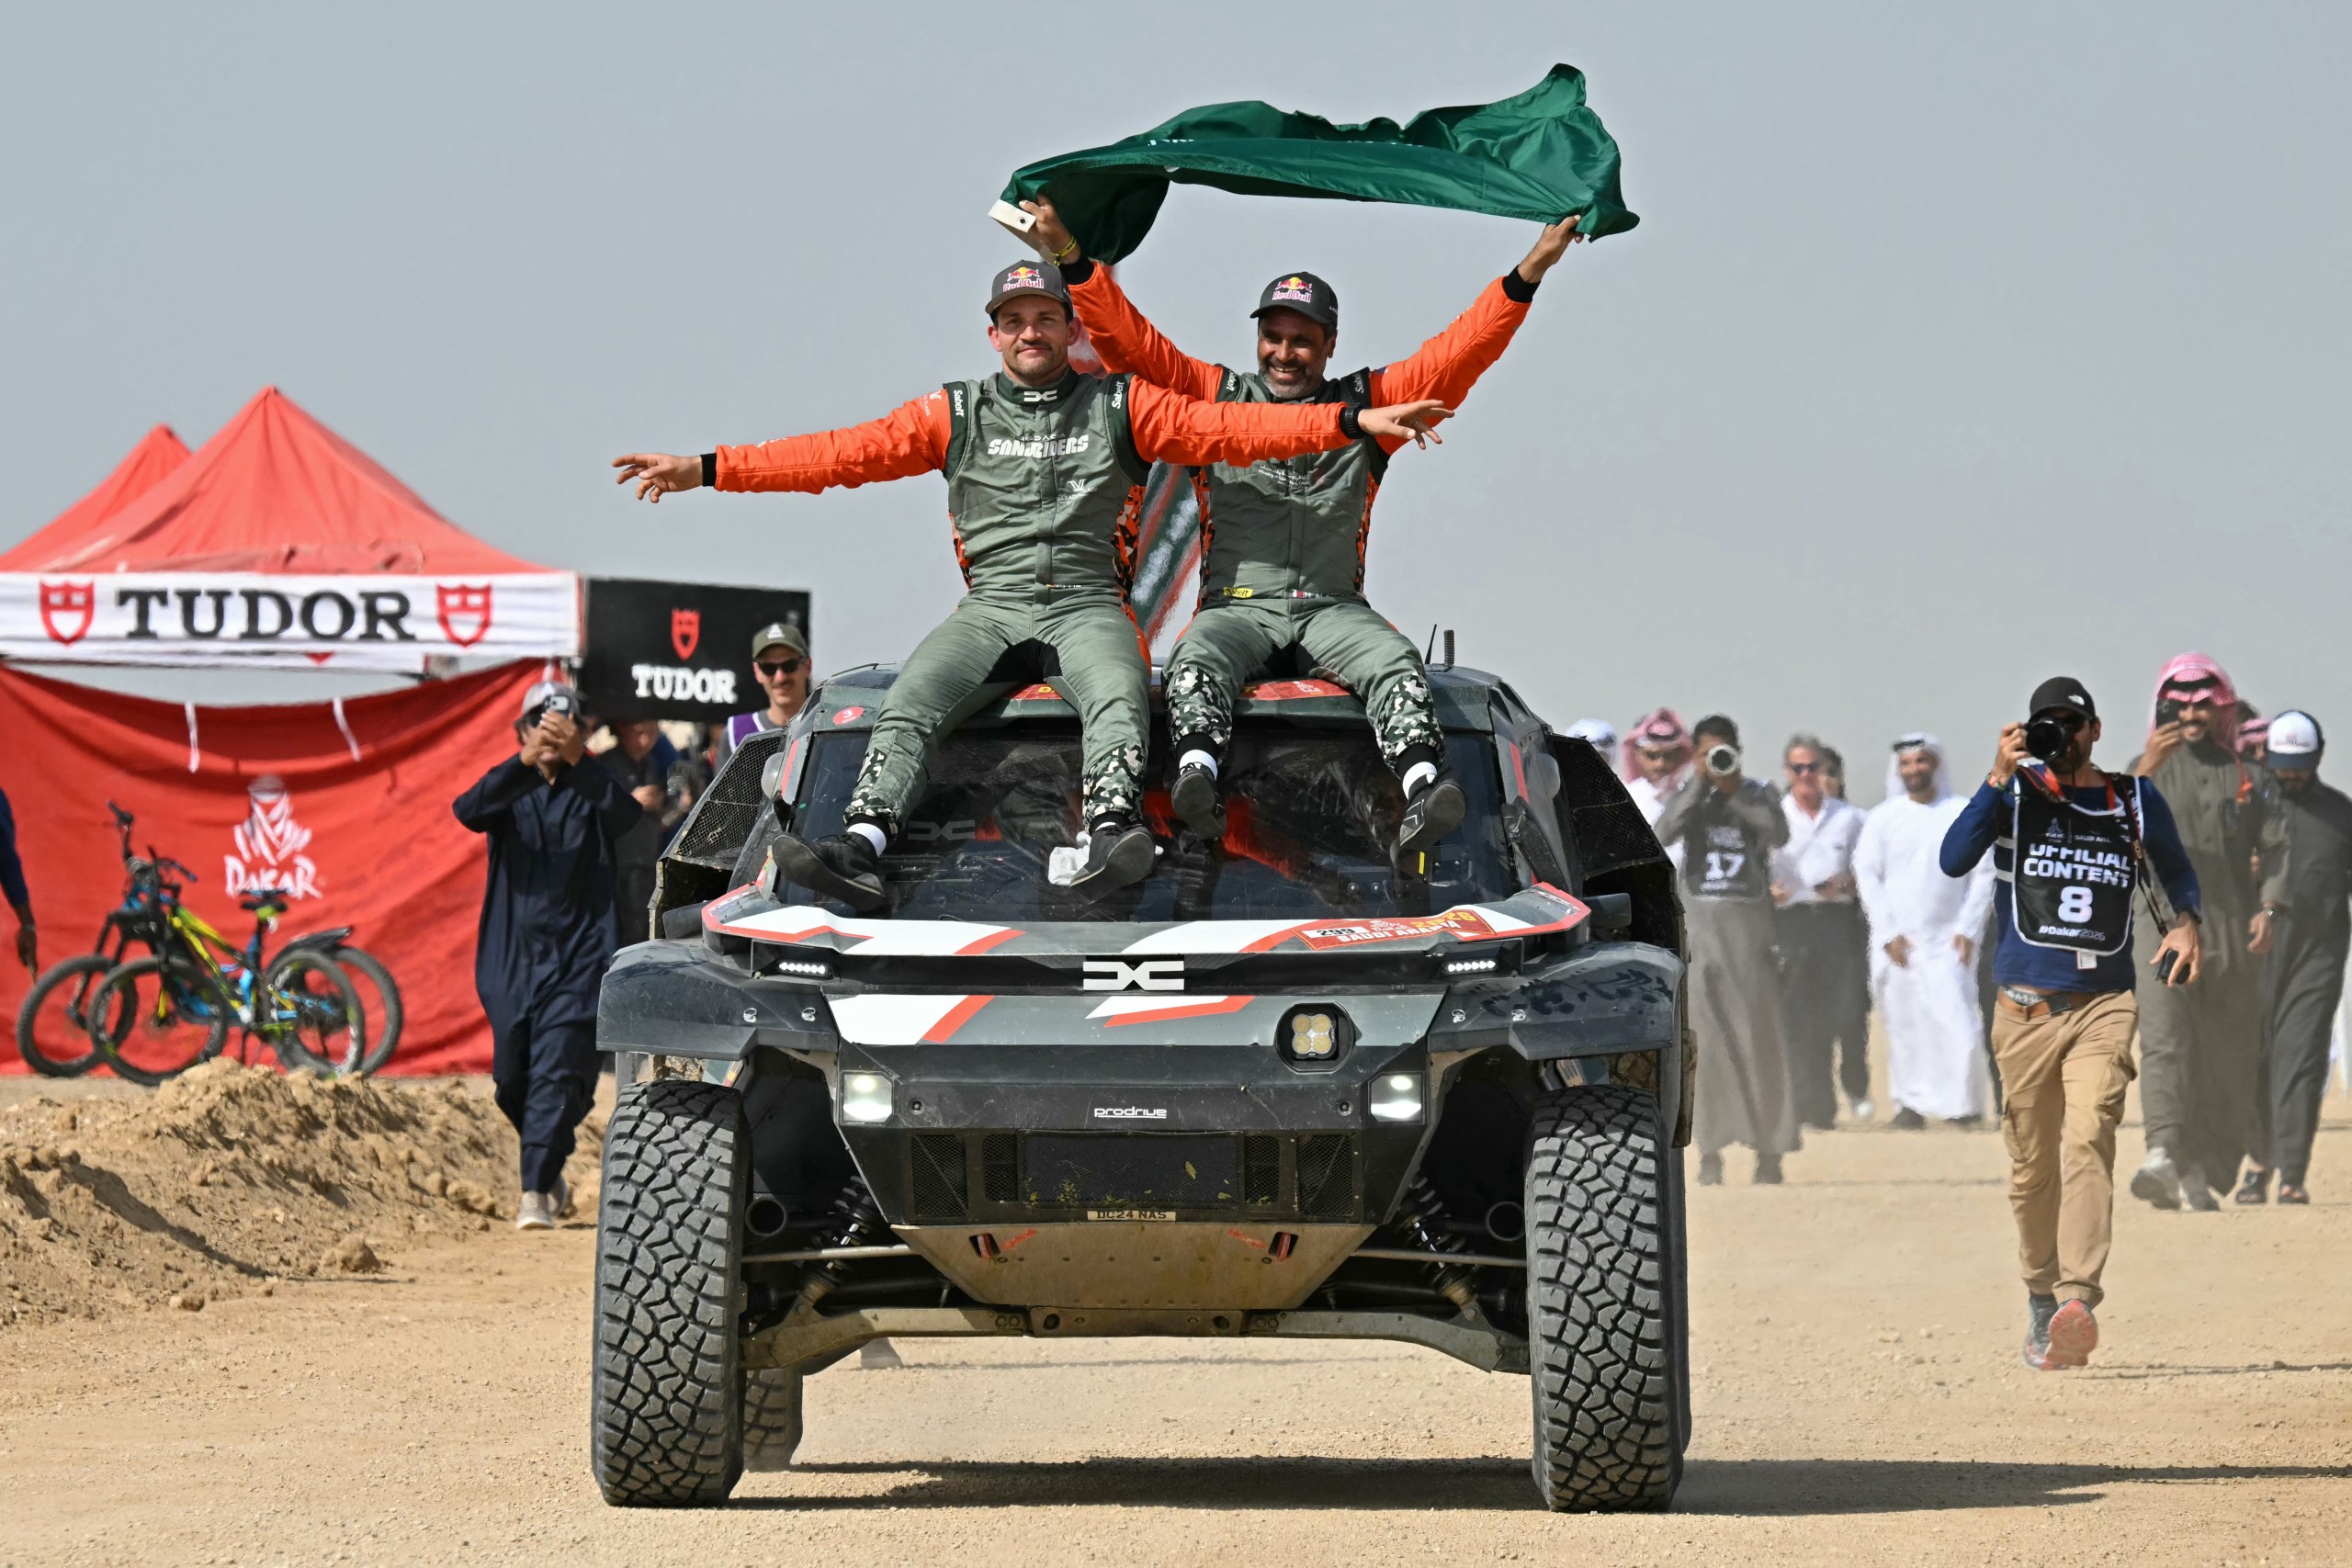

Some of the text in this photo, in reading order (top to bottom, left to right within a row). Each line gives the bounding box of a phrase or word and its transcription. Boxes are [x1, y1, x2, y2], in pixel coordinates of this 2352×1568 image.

[1003, 277, 1045, 292] Red Bull
[1272, 289, 1312, 303] Red Bull
[953, 389, 965, 418] Sabelt
[1111, 381, 1125, 410] Sabelt
[988, 434, 1090, 459] SANDRIDERS
[118, 588, 415, 640] TUDOR
[631, 663, 738, 705] TUDOR
[842, 709, 853, 718] 3
[223, 852, 323, 900] DAKAR
[1705, 852, 1745, 881] 17
[2023, 857, 2131, 888] CONTENT
[2057, 886, 2094, 923] 8
[1317, 928, 1356, 936] 299
[1337, 919, 1462, 942] SAUDI ARABIA
[2038, 925, 2106, 942] #Dakar2026
[1094, 1106, 1167, 1119] prodrive
[1138, 1211, 1167, 1220] NAS
